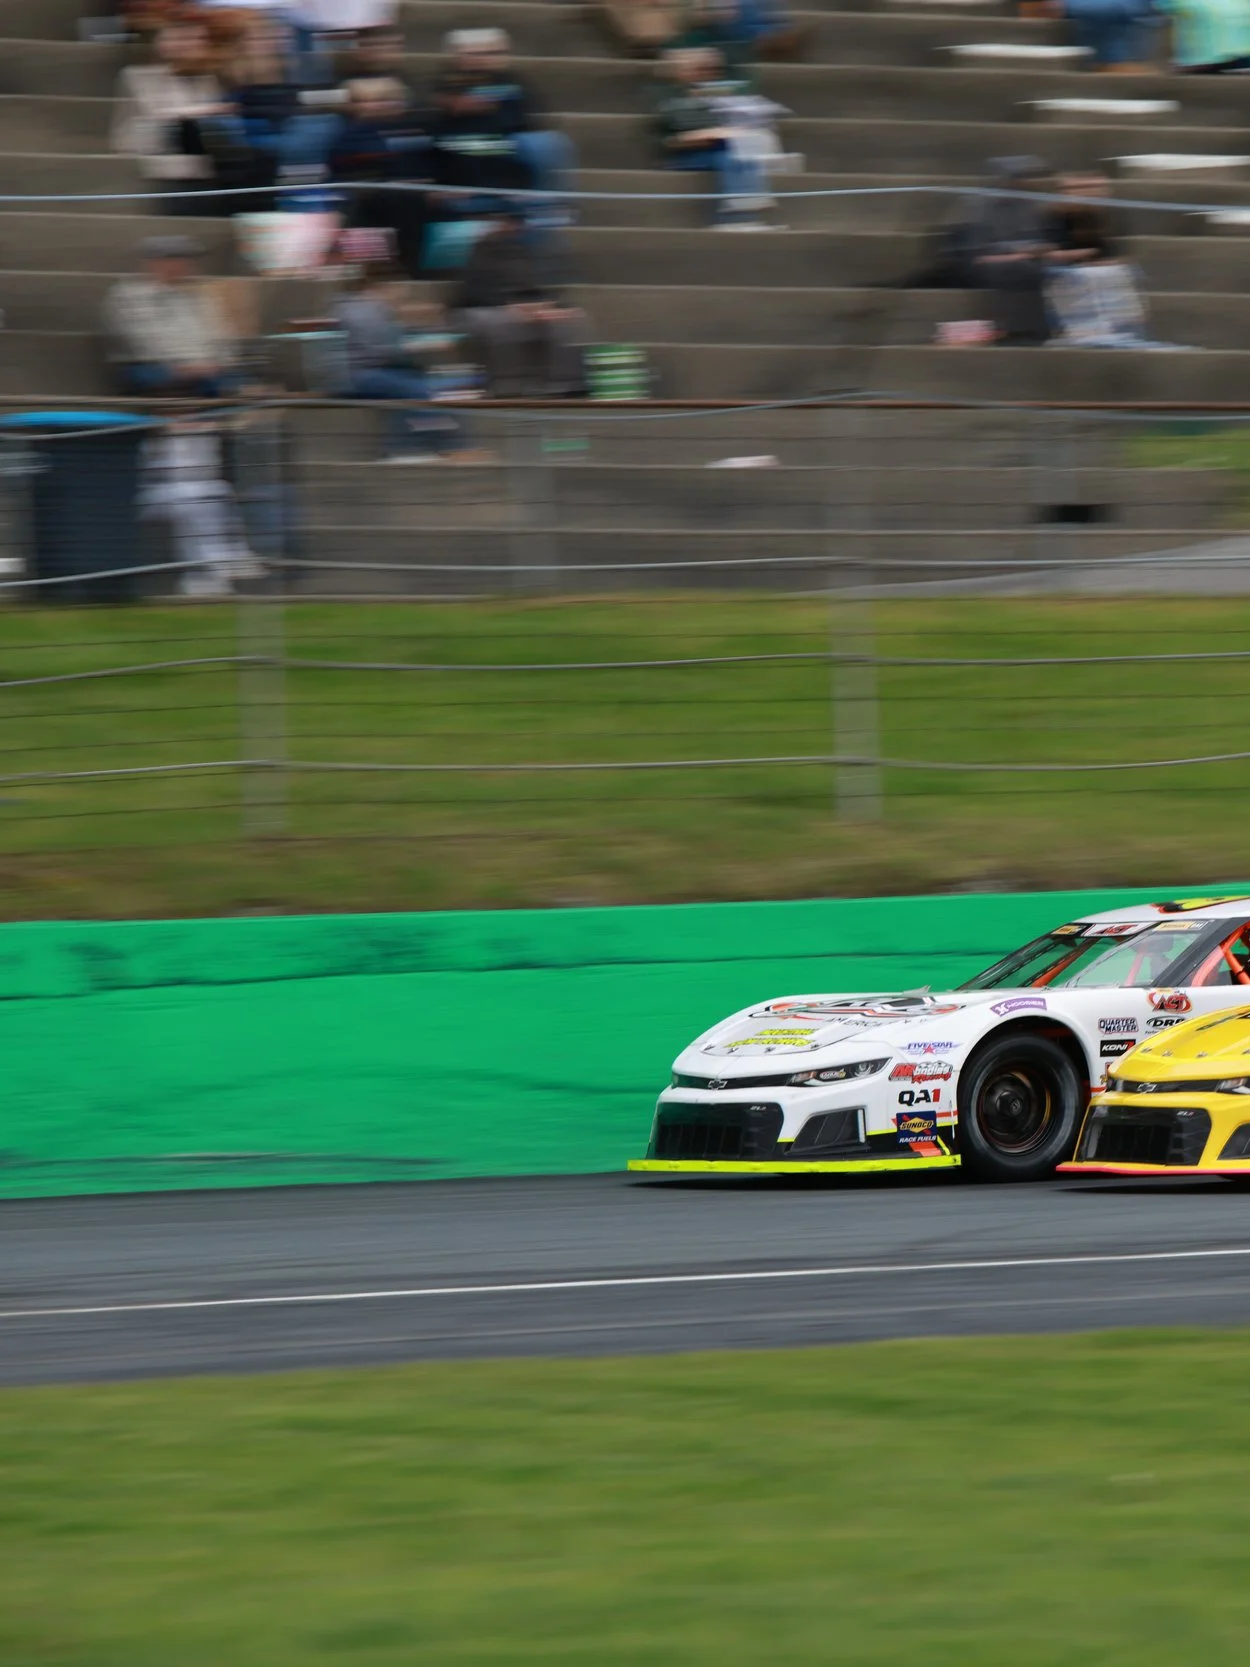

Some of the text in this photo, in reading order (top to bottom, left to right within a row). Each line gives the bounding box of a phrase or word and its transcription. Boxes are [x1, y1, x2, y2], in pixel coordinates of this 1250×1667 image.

[1101, 1043, 1129, 1052] KONI
[898, 1088, 941, 1107] QA1
[901, 1121, 933, 1129] SUNOCO
